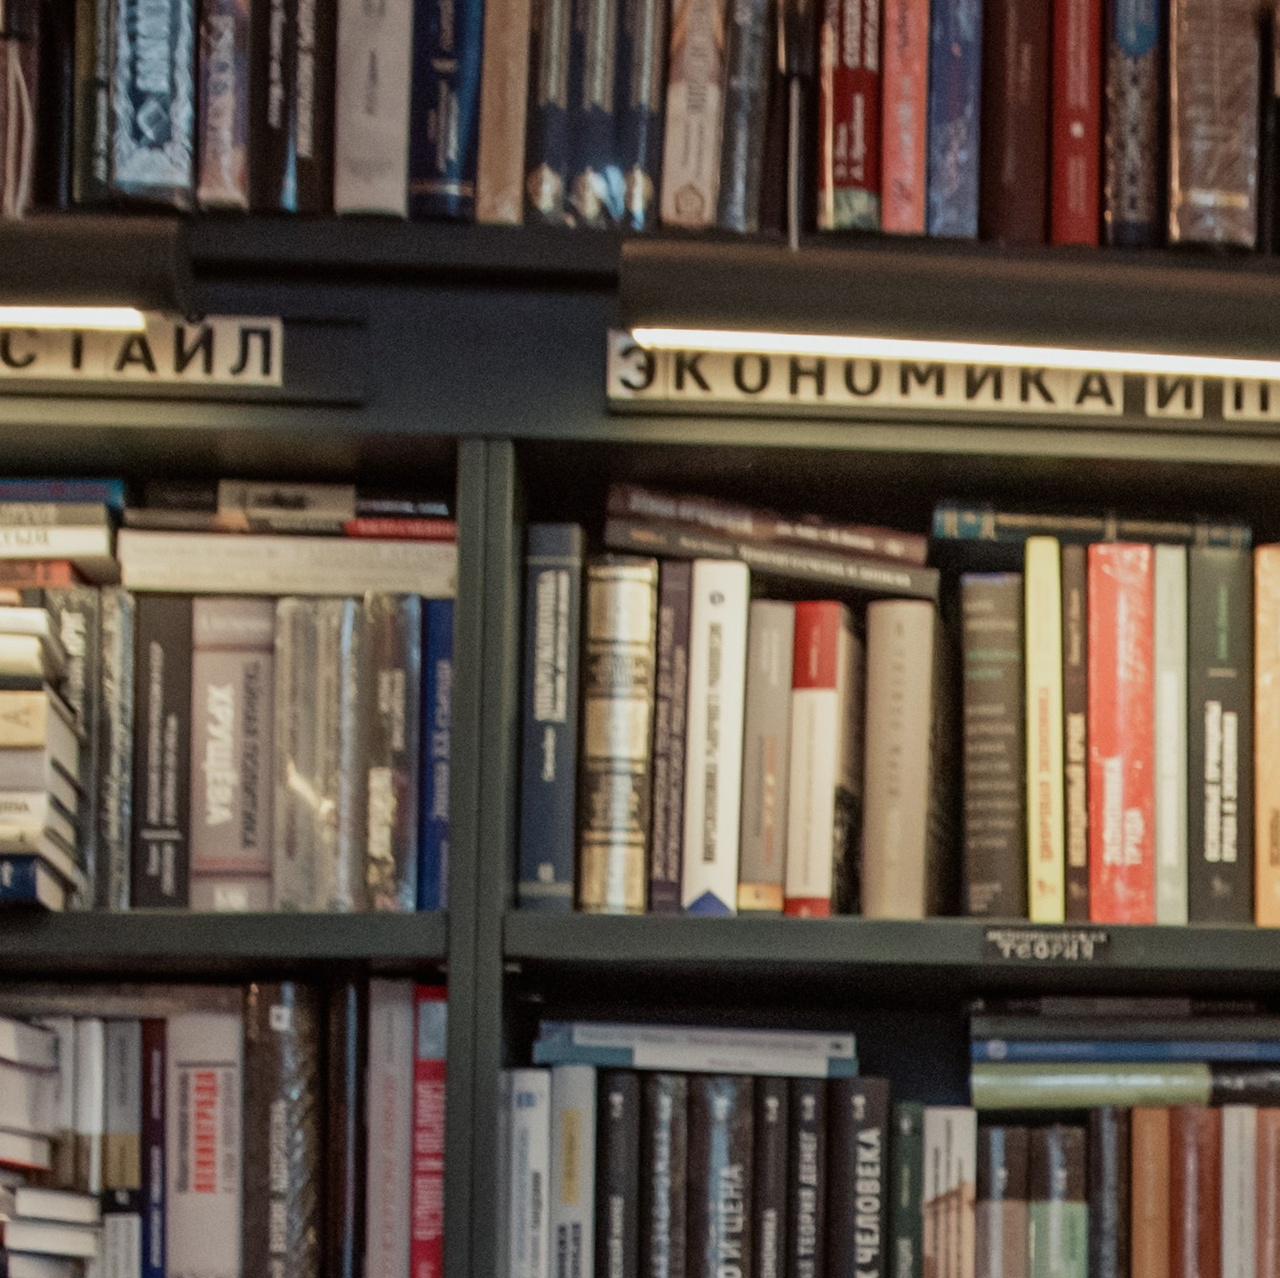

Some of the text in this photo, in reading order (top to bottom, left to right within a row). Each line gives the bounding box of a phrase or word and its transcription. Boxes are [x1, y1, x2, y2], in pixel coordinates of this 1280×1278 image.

[619, 342, 1113, 408] ЭКОНОМИКА
[1157, 375, 1193, 410] И
[800, 1130, 819, 1186] ДЕНЕГ
[719, 1163, 747, 1232] ЦЕНА
[799, 1189, 817, 1256] ТЕОРИЯ
[855, 1127, 882, 1264] ЧЕЛОВЕКА
[717, 1240, 743, 1258] И
